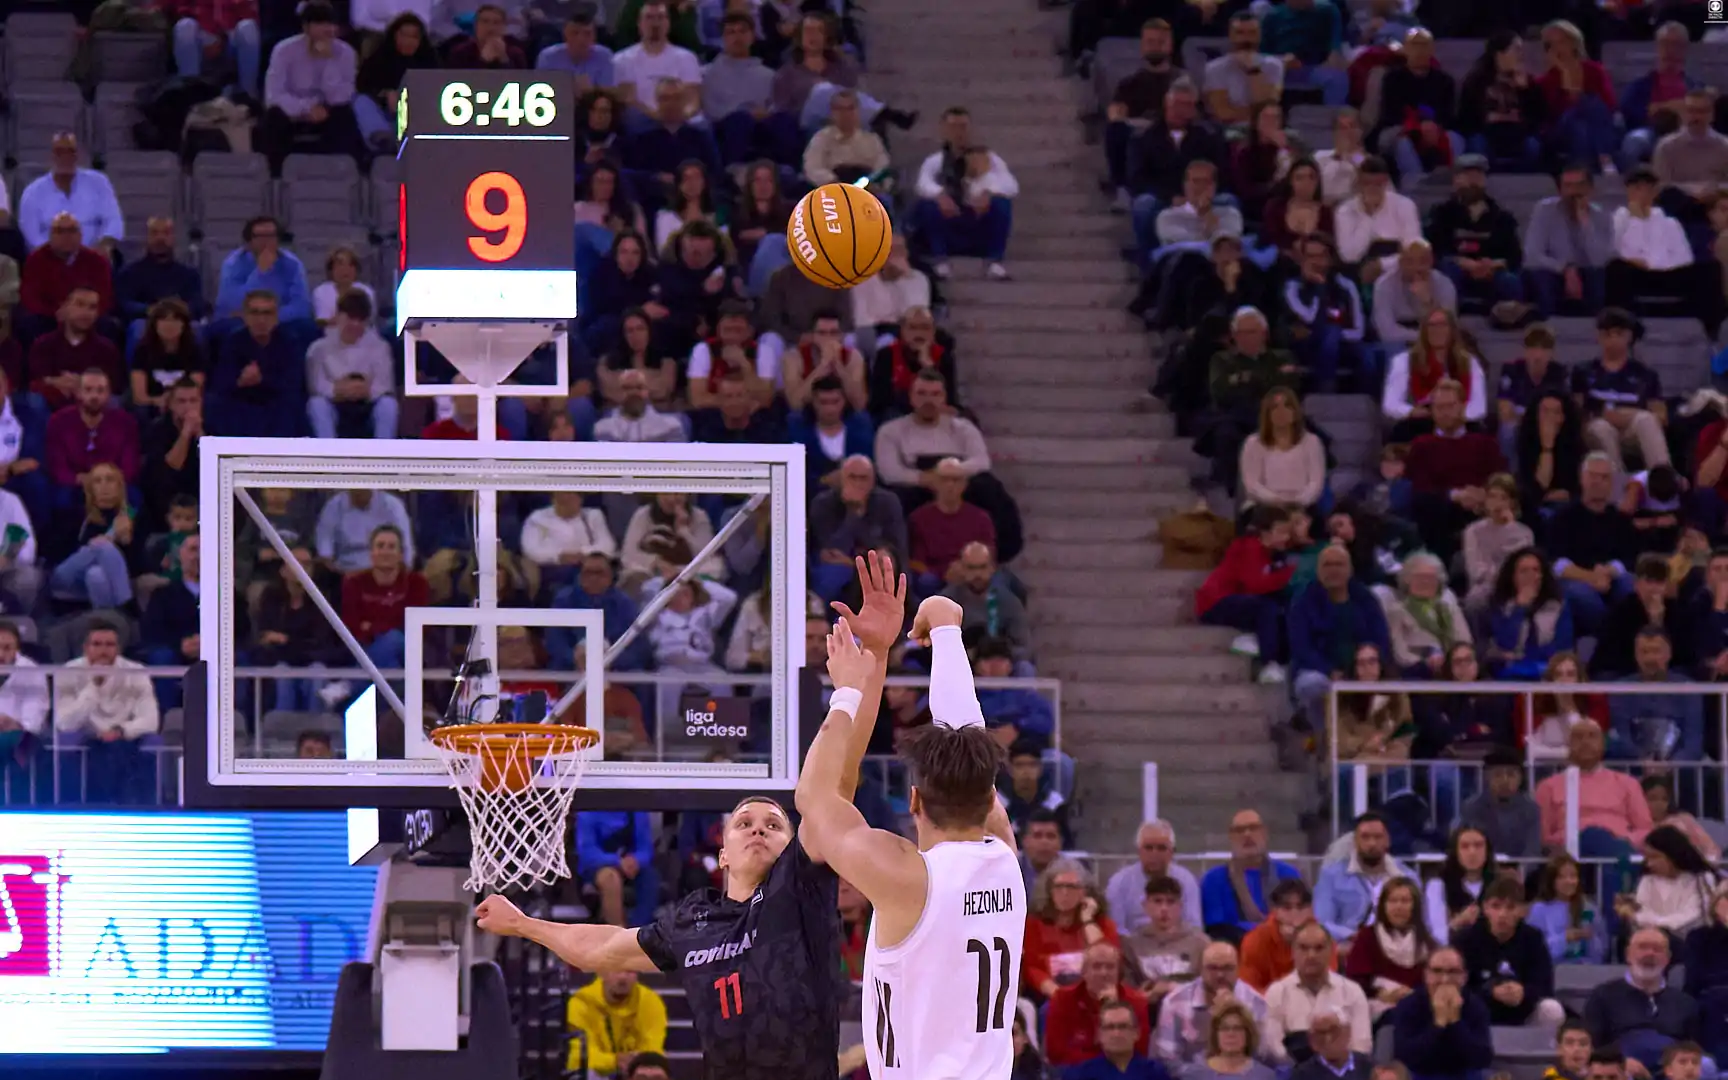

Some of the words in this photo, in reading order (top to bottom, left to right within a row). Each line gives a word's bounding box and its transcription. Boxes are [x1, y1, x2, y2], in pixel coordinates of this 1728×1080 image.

[440, 82, 557, 127] 6:46
[464, 171, 529, 263] 9
[685, 709, 714, 724] liga
[686, 723, 748, 737] endesa
[963, 888, 1013, 916] HEZONJA
[714, 971, 743, 1020] 11
[967, 936, 1011, 1033] 11
